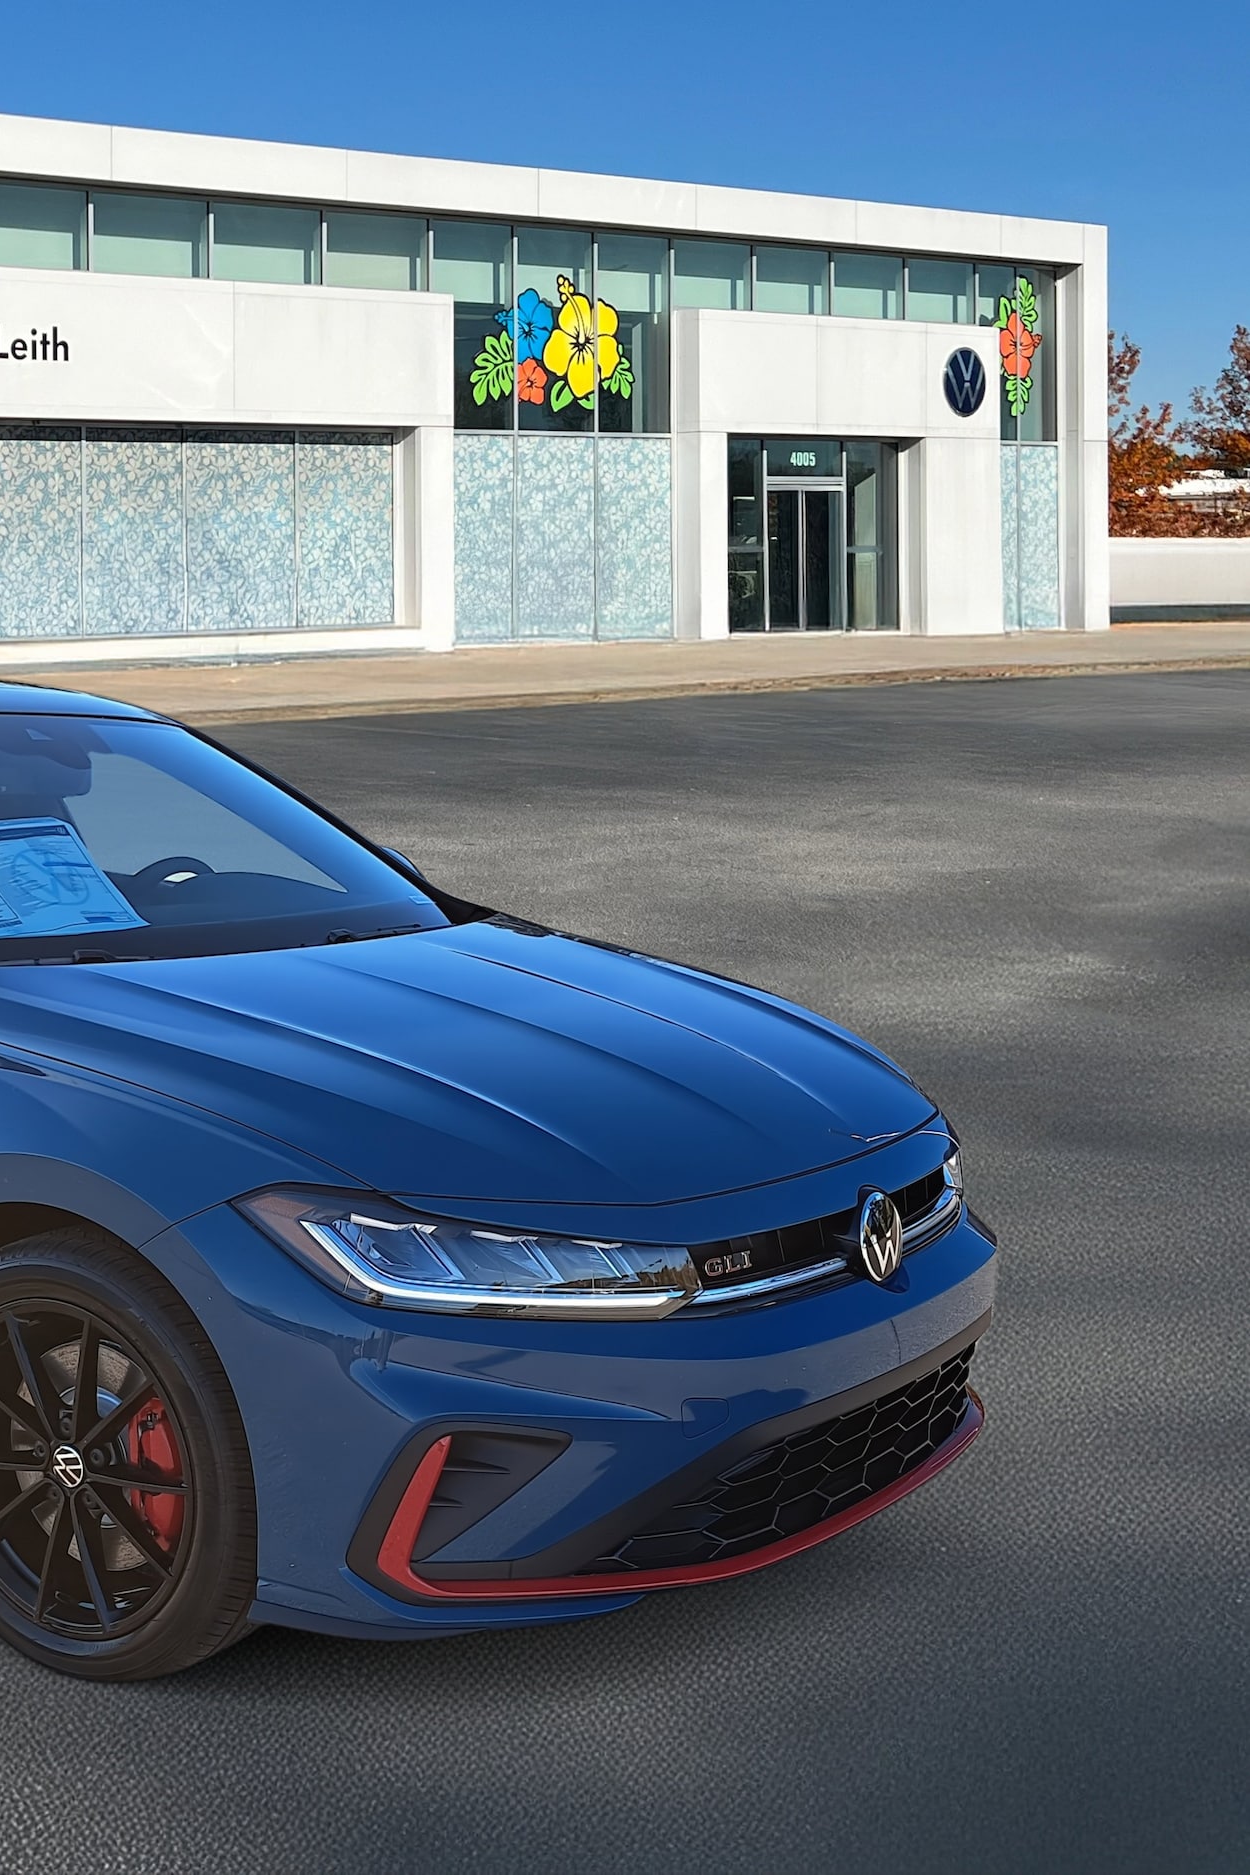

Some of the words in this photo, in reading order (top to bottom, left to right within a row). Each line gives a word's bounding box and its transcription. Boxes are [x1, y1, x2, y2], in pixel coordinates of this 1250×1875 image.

[944, 348, 985, 415] VW
[790, 451, 816, 466] 4005
[705, 1250, 752, 1276] GLI
